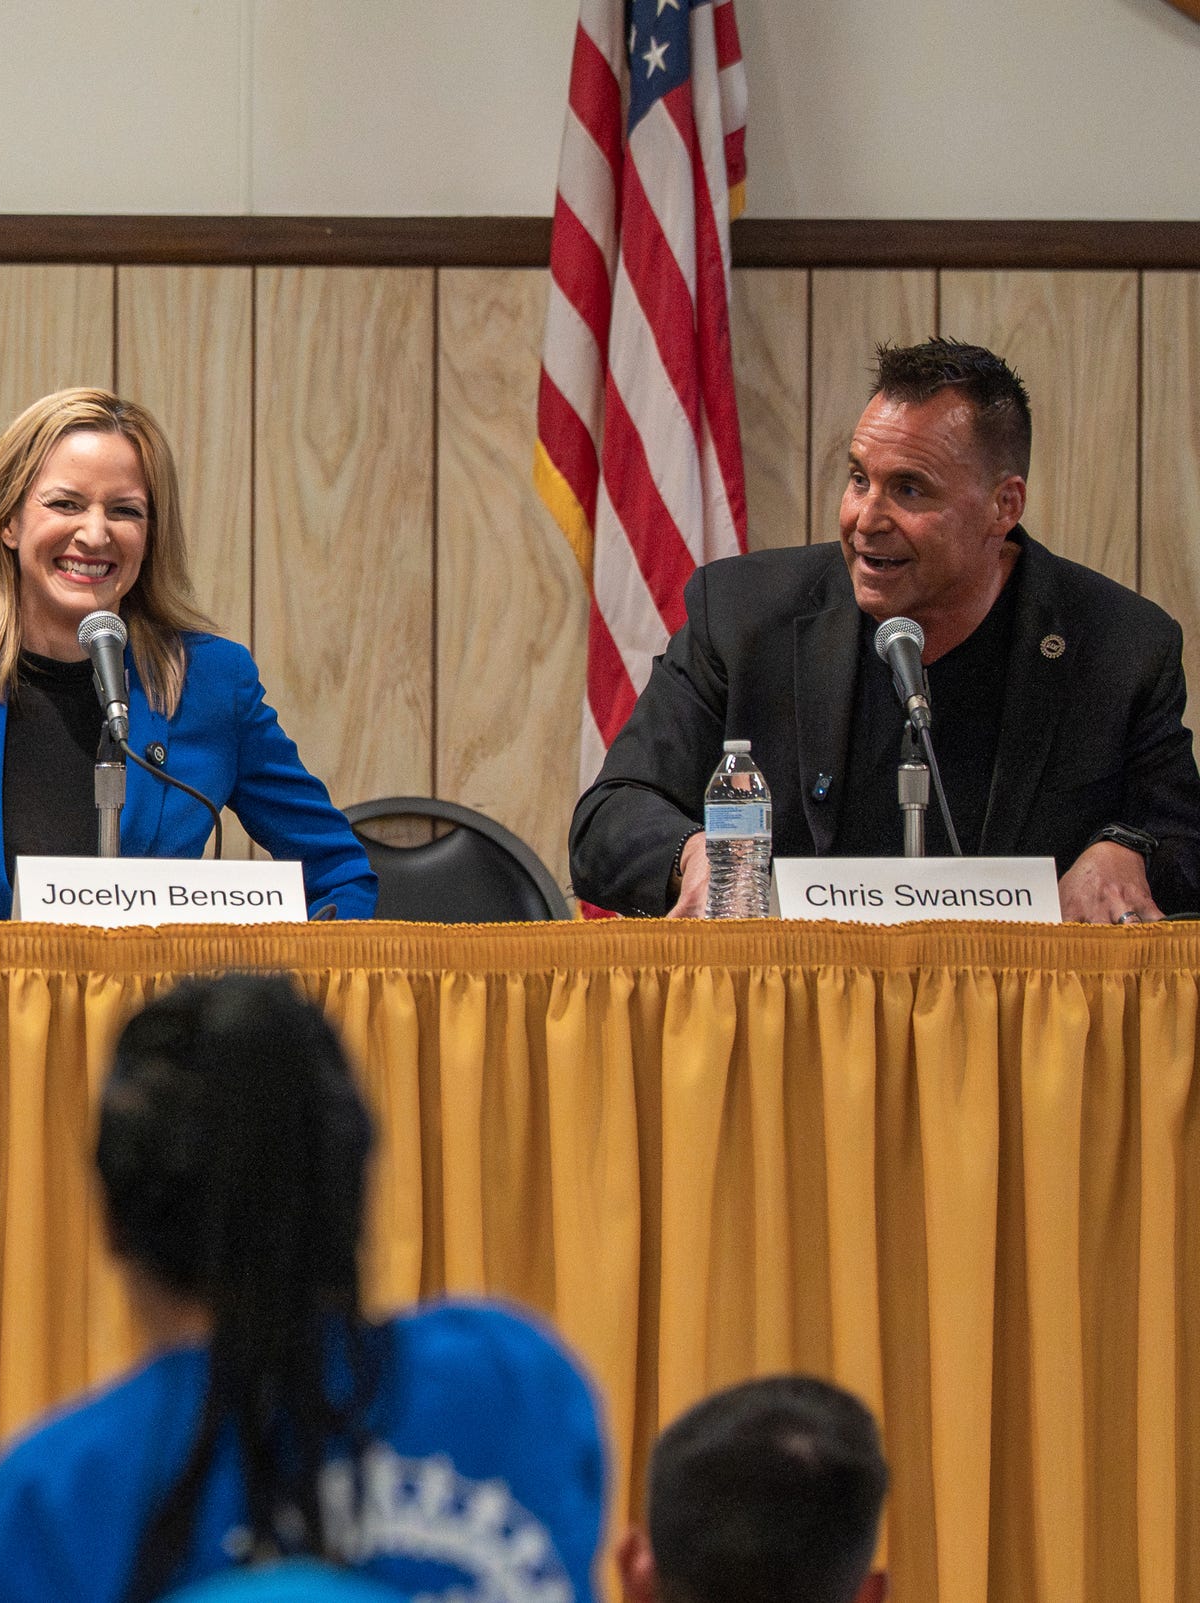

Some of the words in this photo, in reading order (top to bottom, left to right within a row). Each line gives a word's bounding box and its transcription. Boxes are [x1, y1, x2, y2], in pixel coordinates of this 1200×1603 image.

[41, 883, 157, 912] Jocelyn
[168, 885, 283, 907] Benson
[805, 883, 884, 907] Chris
[894, 884, 1032, 907] Swanson
